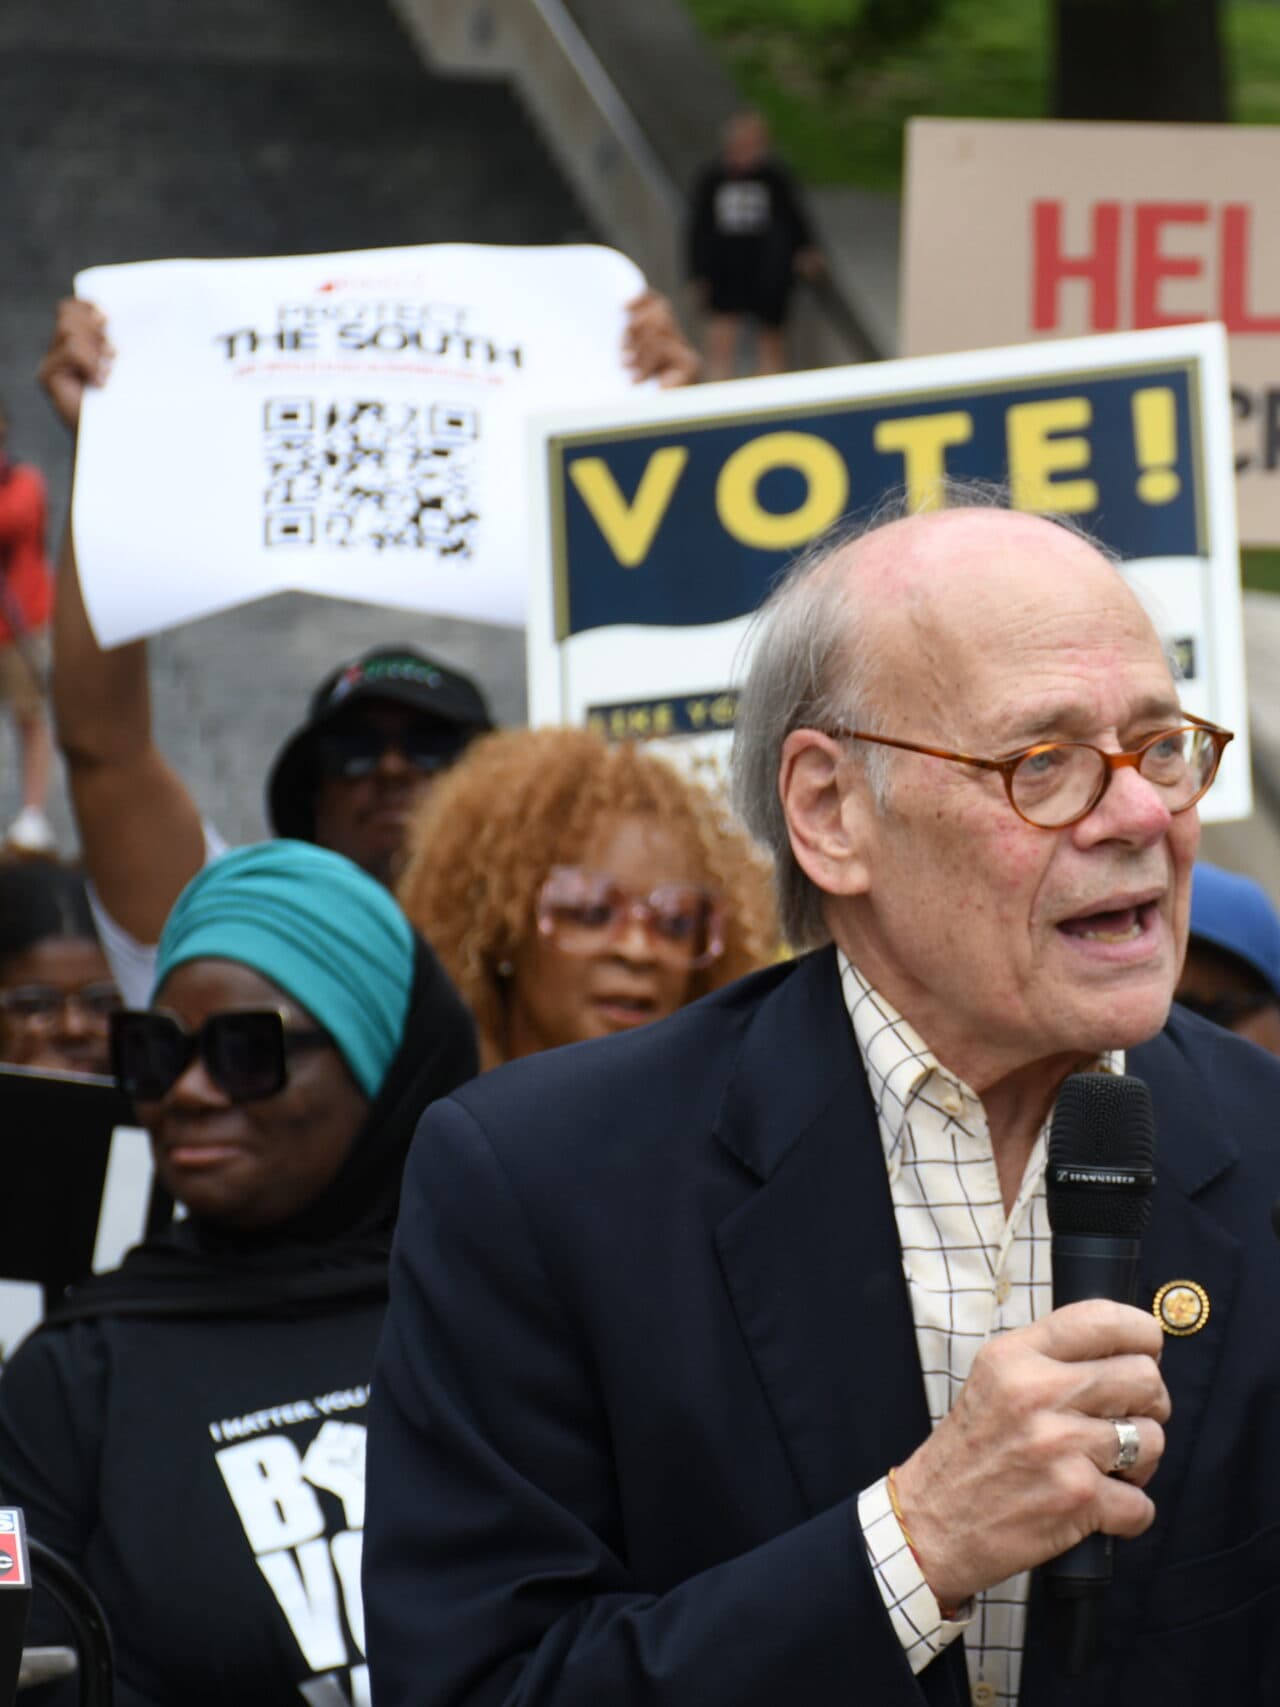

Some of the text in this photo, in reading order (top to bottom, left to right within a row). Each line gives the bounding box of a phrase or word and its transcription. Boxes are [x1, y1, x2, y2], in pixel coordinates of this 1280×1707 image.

[215, 322, 523, 369] THE SOUTH
[568, 386, 1182, 568] VOTE!
